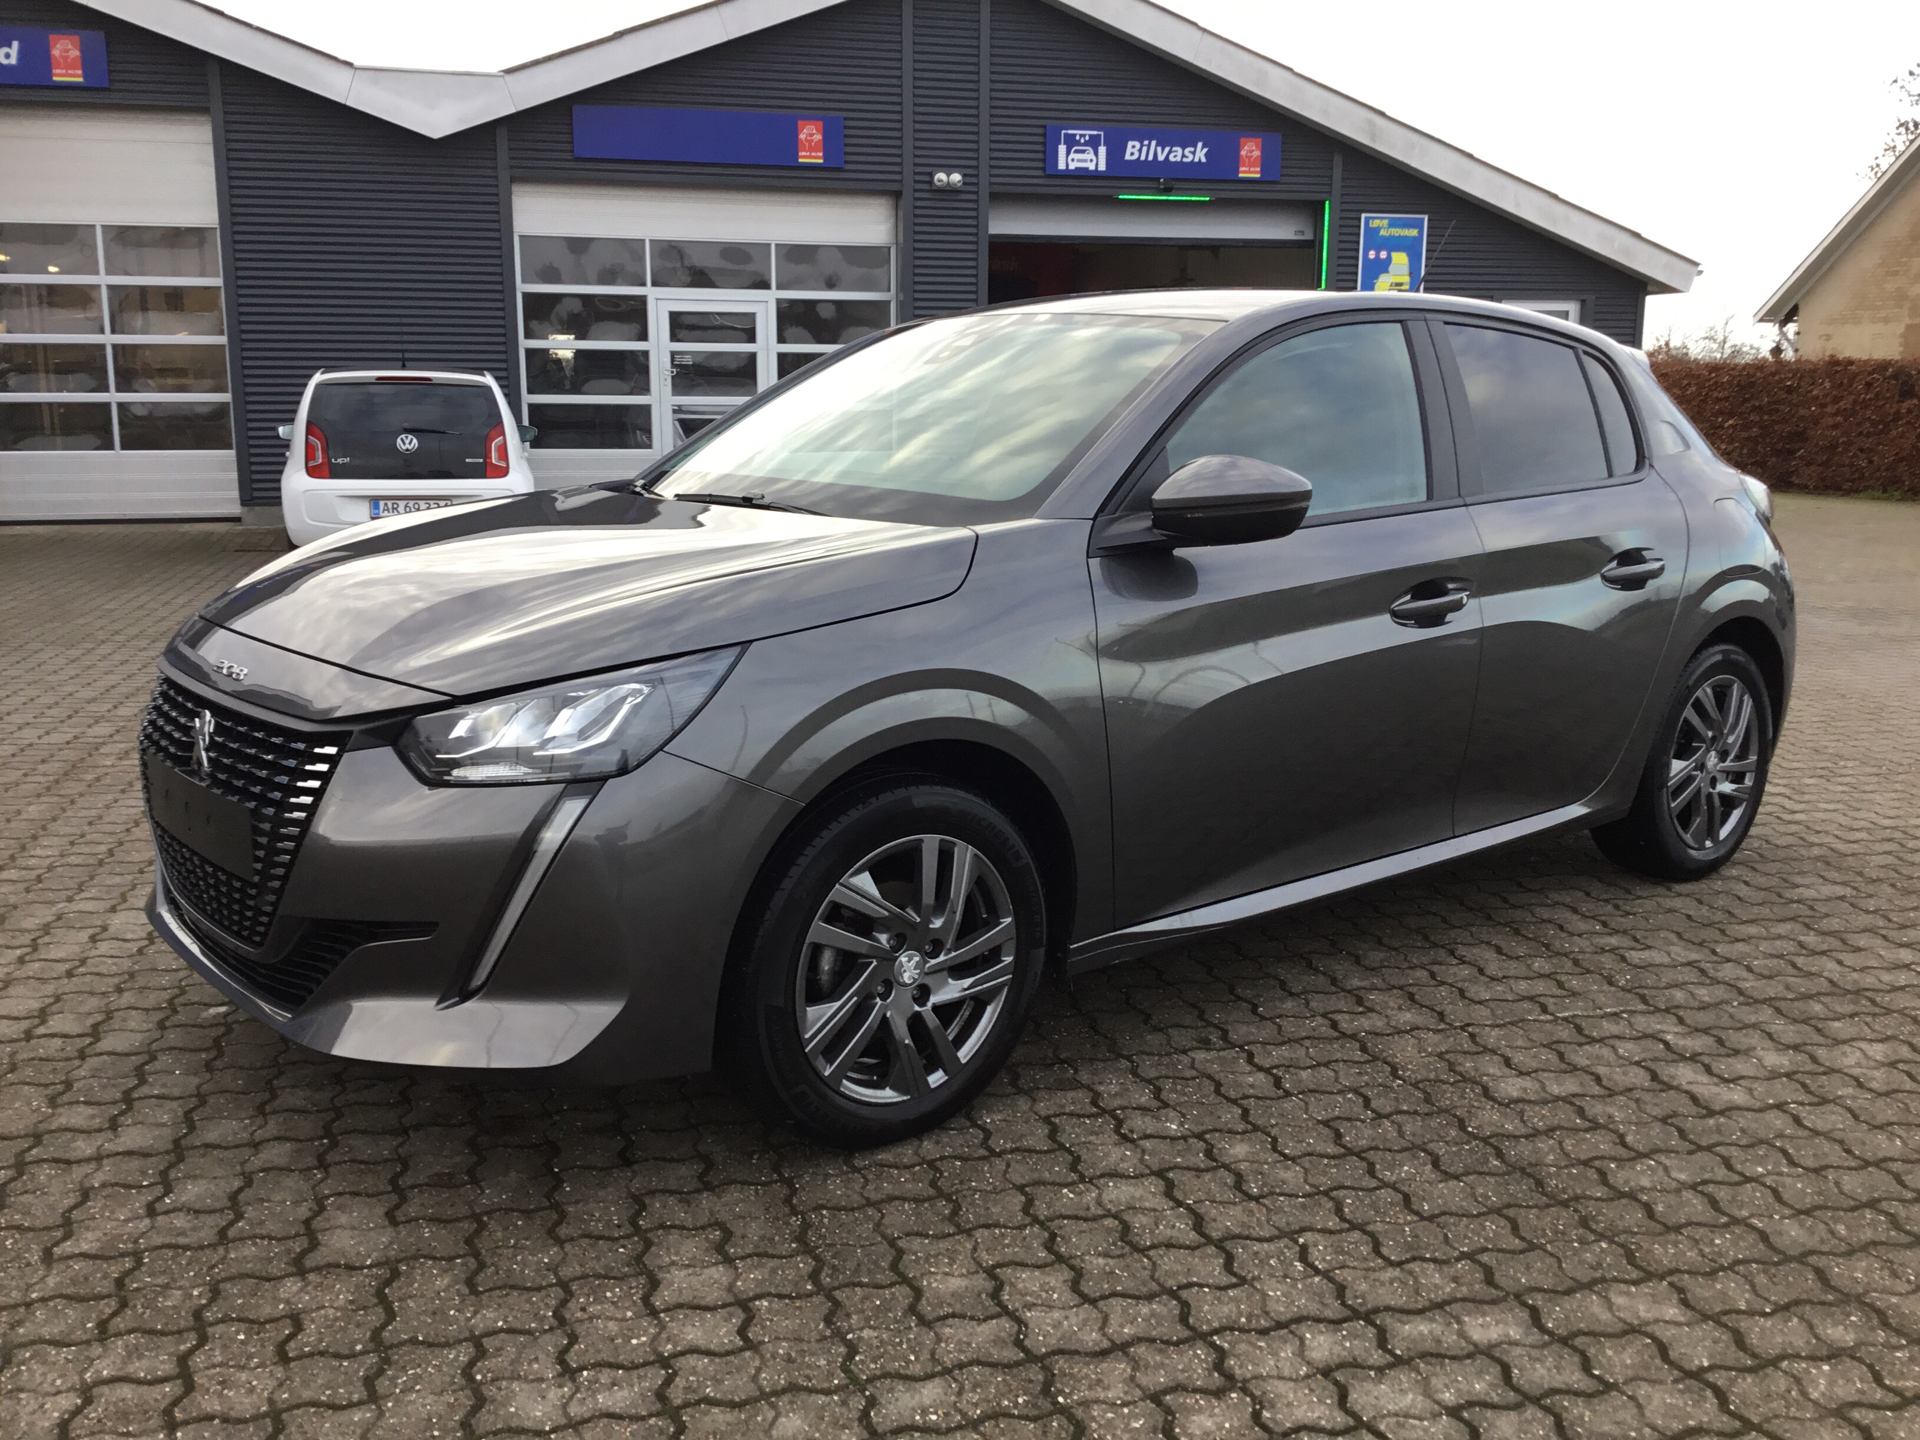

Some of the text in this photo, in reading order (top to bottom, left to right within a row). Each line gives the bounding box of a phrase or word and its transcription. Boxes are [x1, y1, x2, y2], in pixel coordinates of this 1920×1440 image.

[1124, 140, 1209, 163] Bilvask
[1369, 219, 1389, 227] LØVE
[1379, 228, 1419, 236] AUTOVASK
[382, 502, 400, 514] AR
[404, 502, 421, 513] 69
[212, 659, 248, 681] 208
